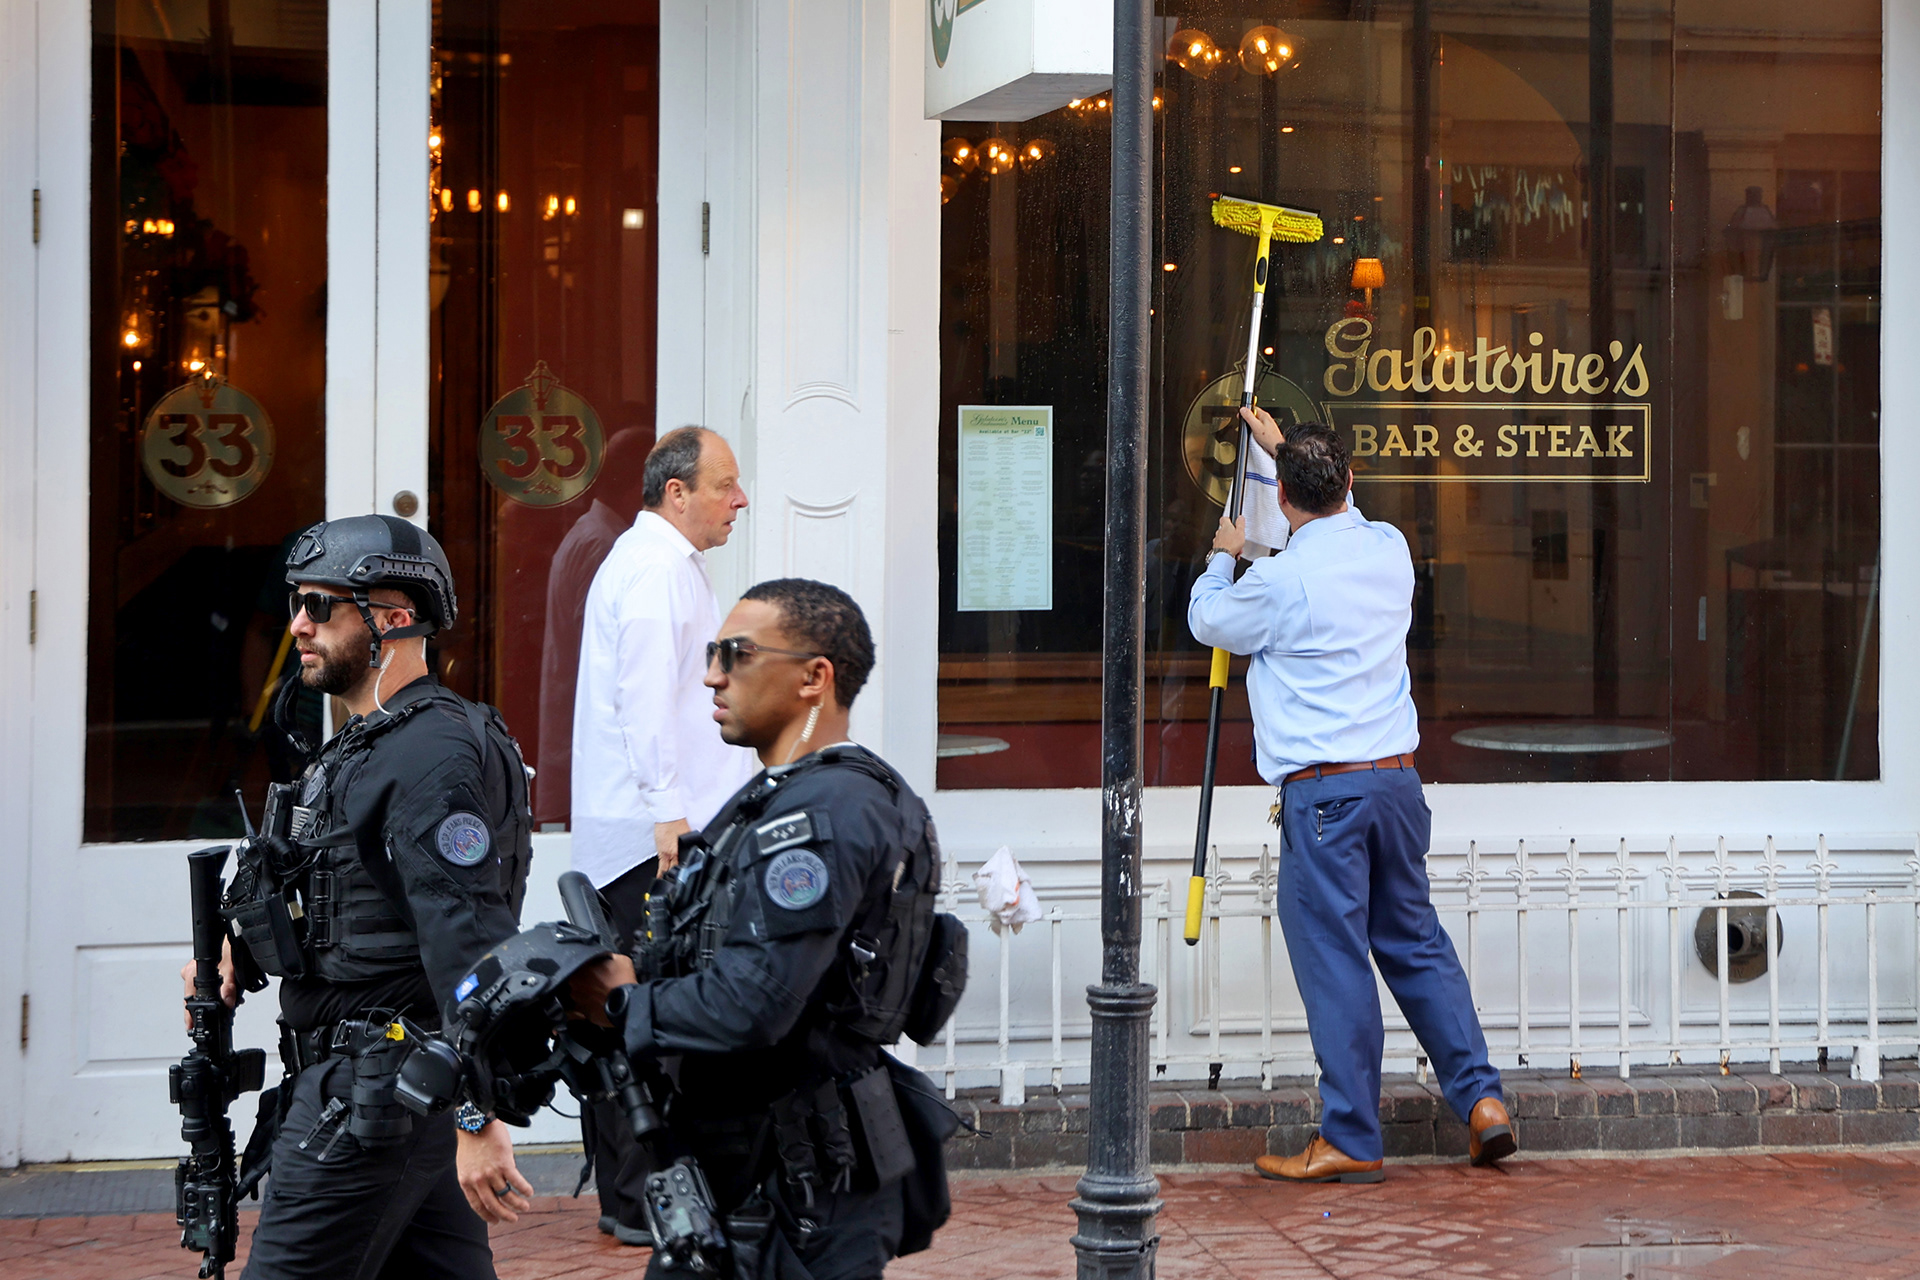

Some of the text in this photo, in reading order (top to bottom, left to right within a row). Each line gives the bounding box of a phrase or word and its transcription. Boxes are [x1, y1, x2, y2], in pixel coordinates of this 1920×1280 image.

[1323, 317, 1650, 397] Galatoire's
[158, 412, 258, 479] 33
[1011, 416, 1039, 425] Menu
[1352, 424, 1634, 457] BAR & STEAK
[495, 414, 591, 481] 33
[441, 818, 463, 842] ORLEANS
[463, 816, 483, 830] POLICE
